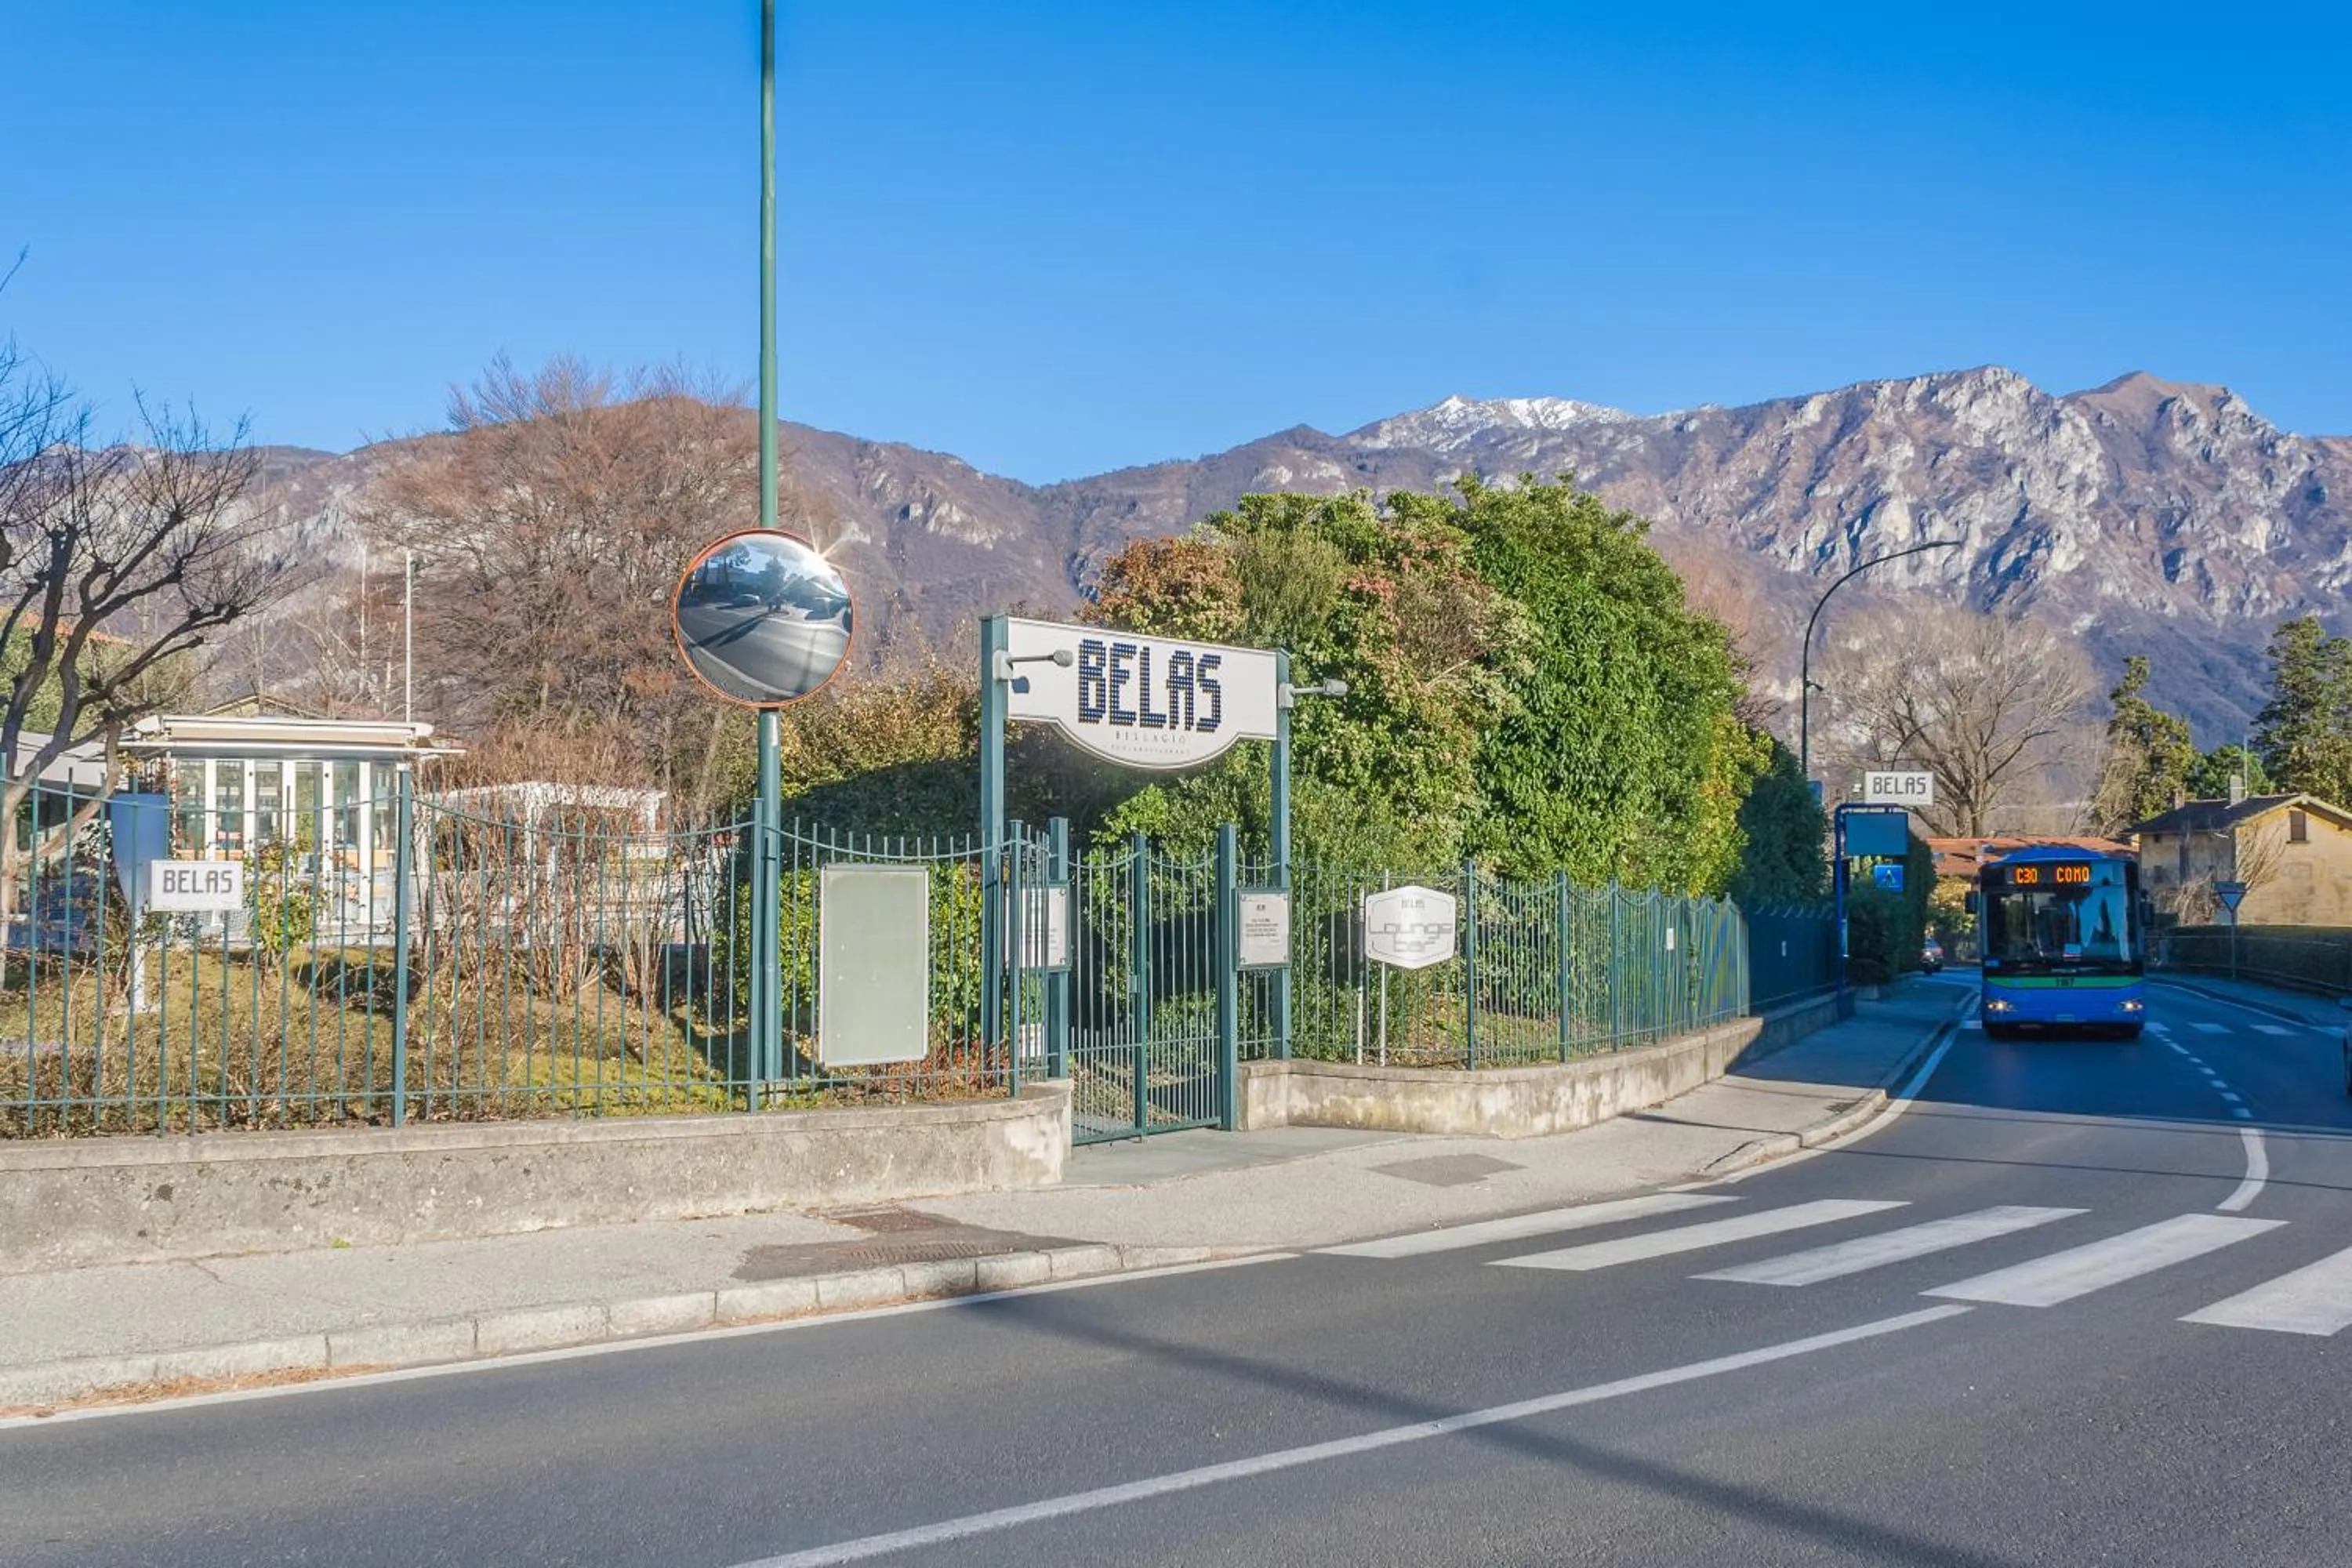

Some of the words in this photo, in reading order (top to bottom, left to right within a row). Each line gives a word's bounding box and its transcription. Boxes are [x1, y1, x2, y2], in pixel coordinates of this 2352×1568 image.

[1078, 638, 1222, 733] BELAS
[1873, 776, 1926, 795] BELAS
[162, 869, 233, 894] BELAS
[2056, 866, 2090, 883] COMO
